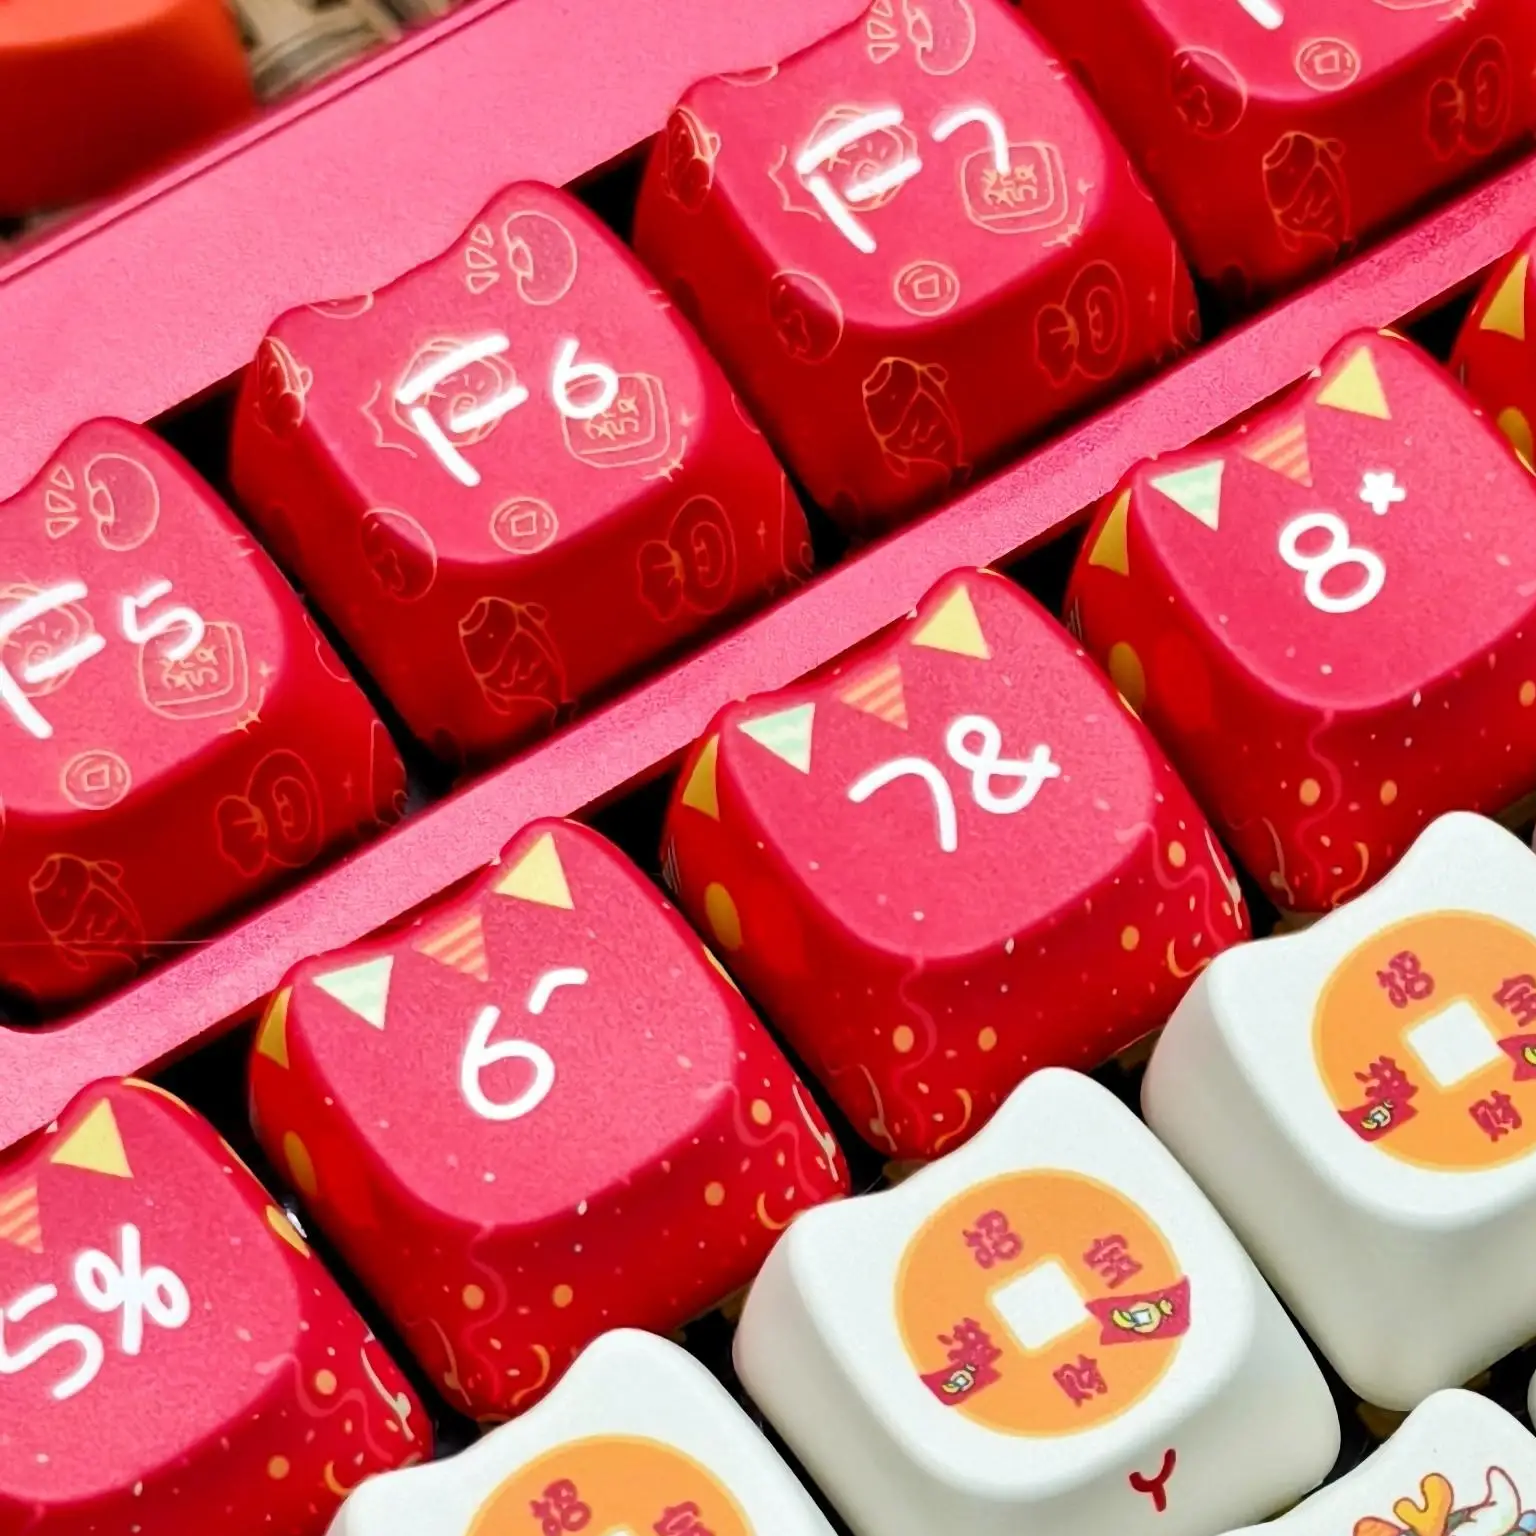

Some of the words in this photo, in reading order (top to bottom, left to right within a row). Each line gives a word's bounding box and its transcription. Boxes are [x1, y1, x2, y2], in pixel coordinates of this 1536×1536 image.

[796, 106, 1013, 254] F7
[394, 334, 619, 486] F6
[0, 580, 206, 739] F5
[848, 715, 1062, 852] 7&
[0, 1223, 190, 1400] 5%
[1128, 1448, 1176, 1513] Y
